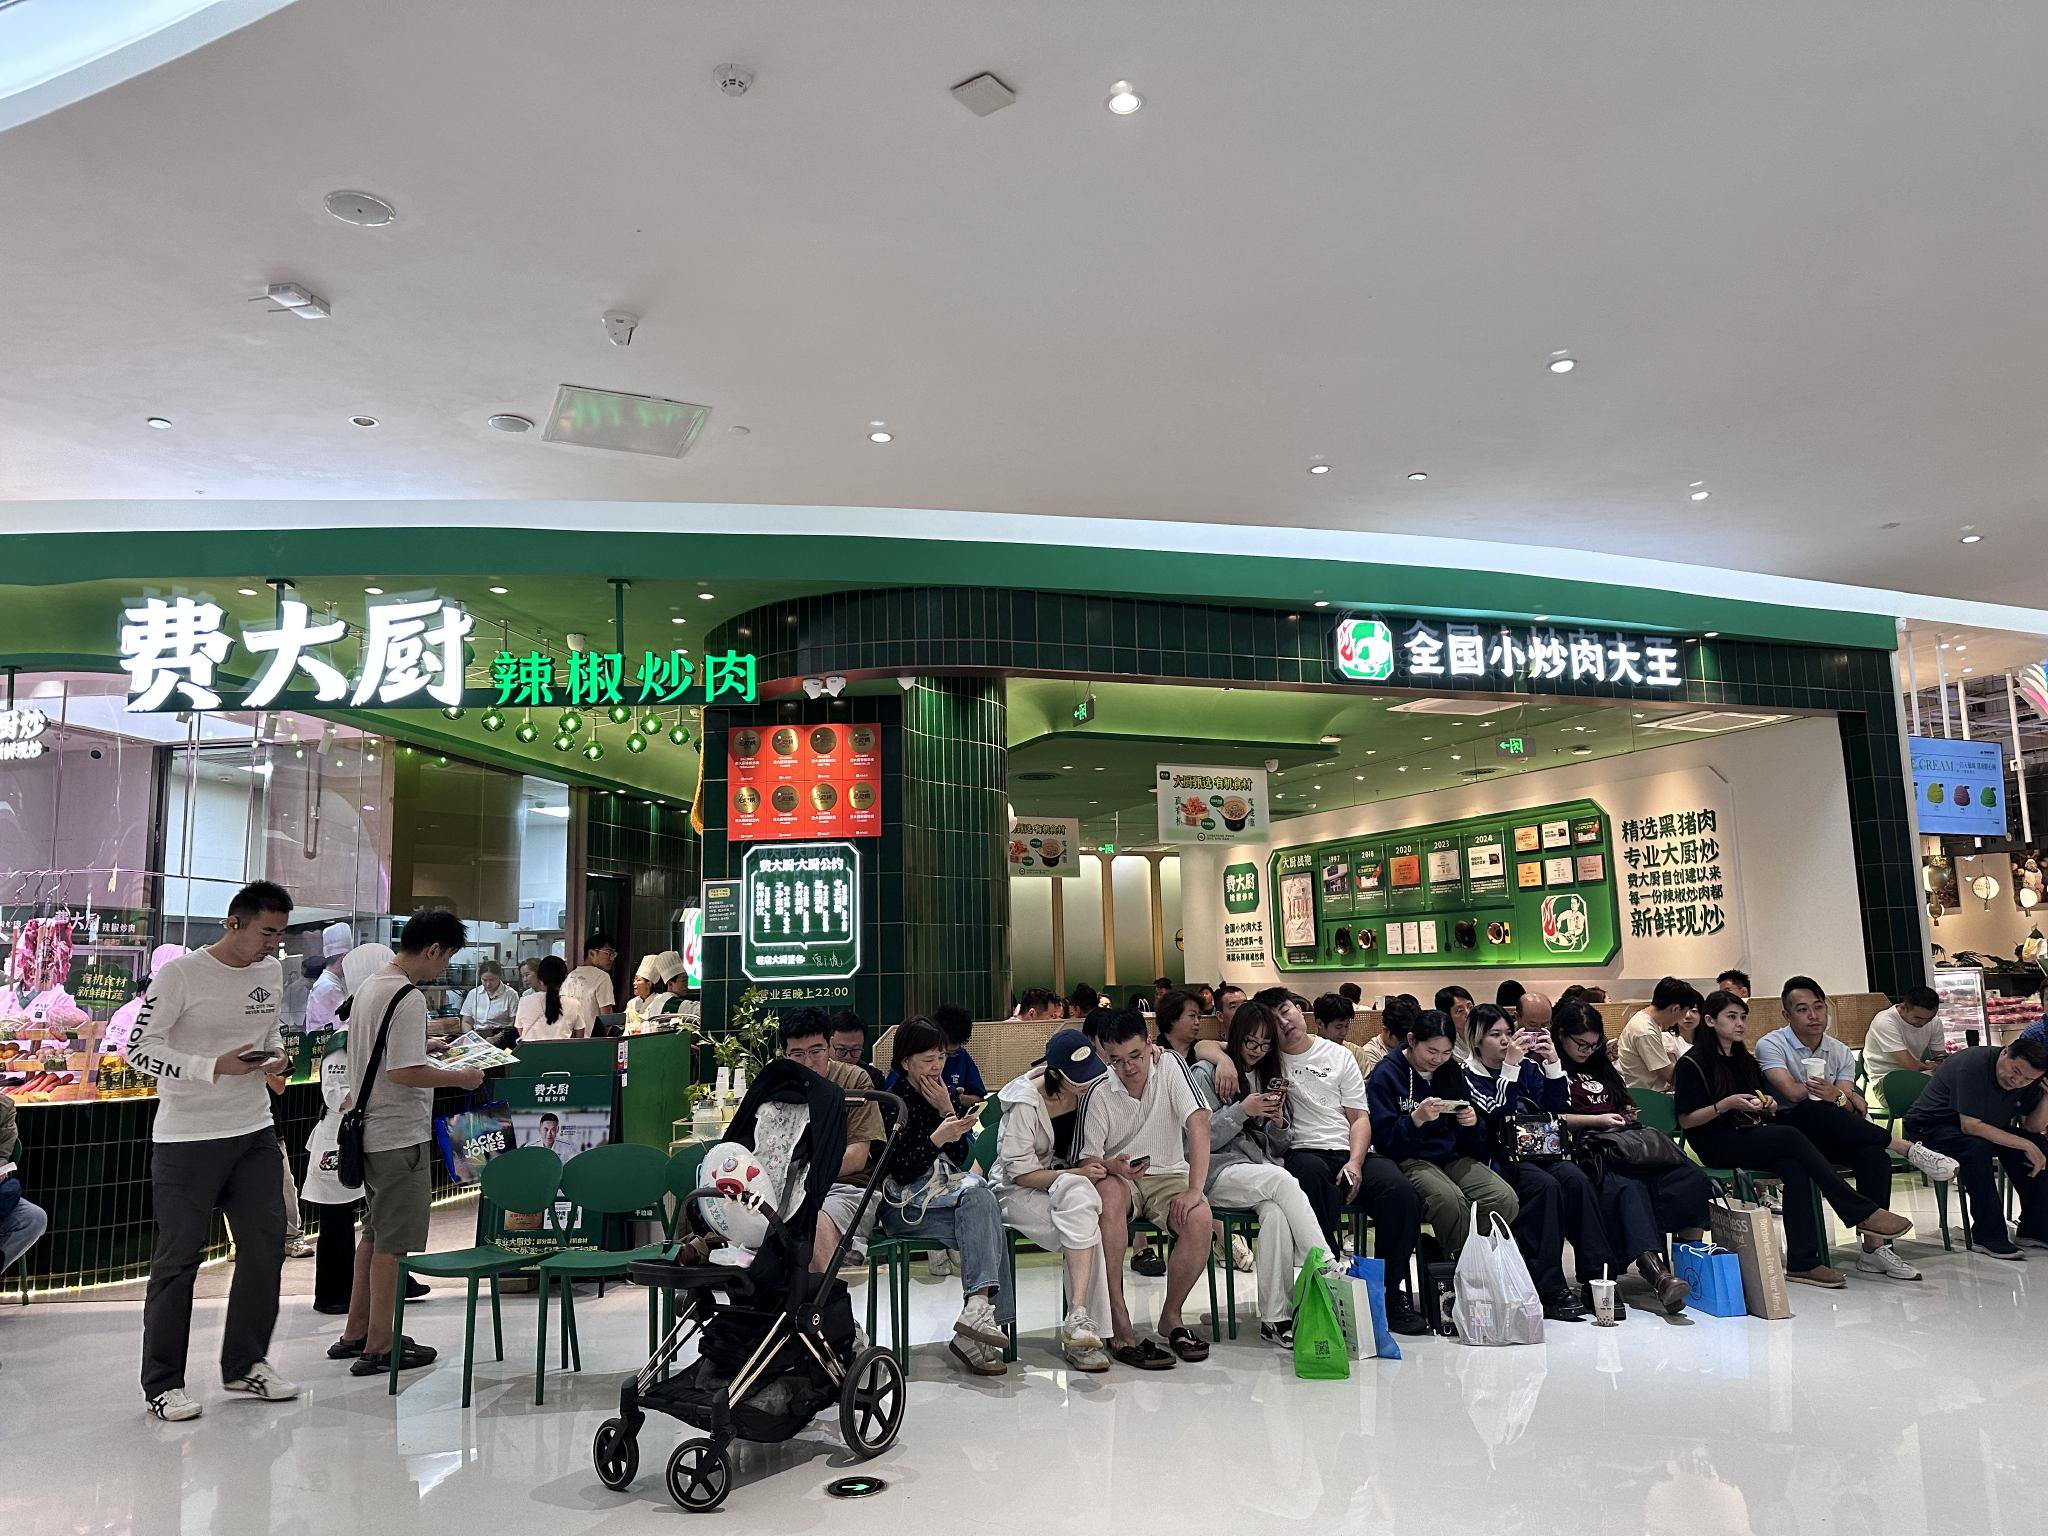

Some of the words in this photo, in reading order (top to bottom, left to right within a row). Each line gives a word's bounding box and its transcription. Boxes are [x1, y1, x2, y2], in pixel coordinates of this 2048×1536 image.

[121, 597, 475, 713] 费大厨
[490, 650, 757, 706] 辣椒炒肉
[1404, 631, 1682, 687] 全国小炒肉大王
[1919, 759, 1953, 772] CREAM
[1621, 808, 1717, 843] 精选黑猪肉
[1434, 840, 1449, 849] 2023
[1475, 834, 1493, 844] 2024
[1395, 846, 1412, 855] 2020
[1623, 837, 1720, 869] 专业大厨炒
[1282, 854, 1312, 869] 大厨战袍
[1226, 872, 1255, 892] 费大厨
[1627, 865, 1722, 888] 费大厨自创建以来
[1628, 884, 1724, 905] 每一份辣椒炒肉都
[102, 923, 136, 933] 辣椒炒肉
[1224, 921, 1263, 934] 全国小炒肉大王
[1630, 904, 1725, 938] 新鲜现炒
[80, 972, 128, 988] 有机食材
[76, 986, 125, 1001] 新鲜时蔬
[126, 995, 158, 1055] YORK
[131, 1052, 182, 1079] NEW
[534, 1084, 569, 1096] 费大厨
[463, 1131, 505, 1150] JACK&
[465, 1140, 506, 1158] JONES
[634, 1209, 653, 1217] 干垃圾
